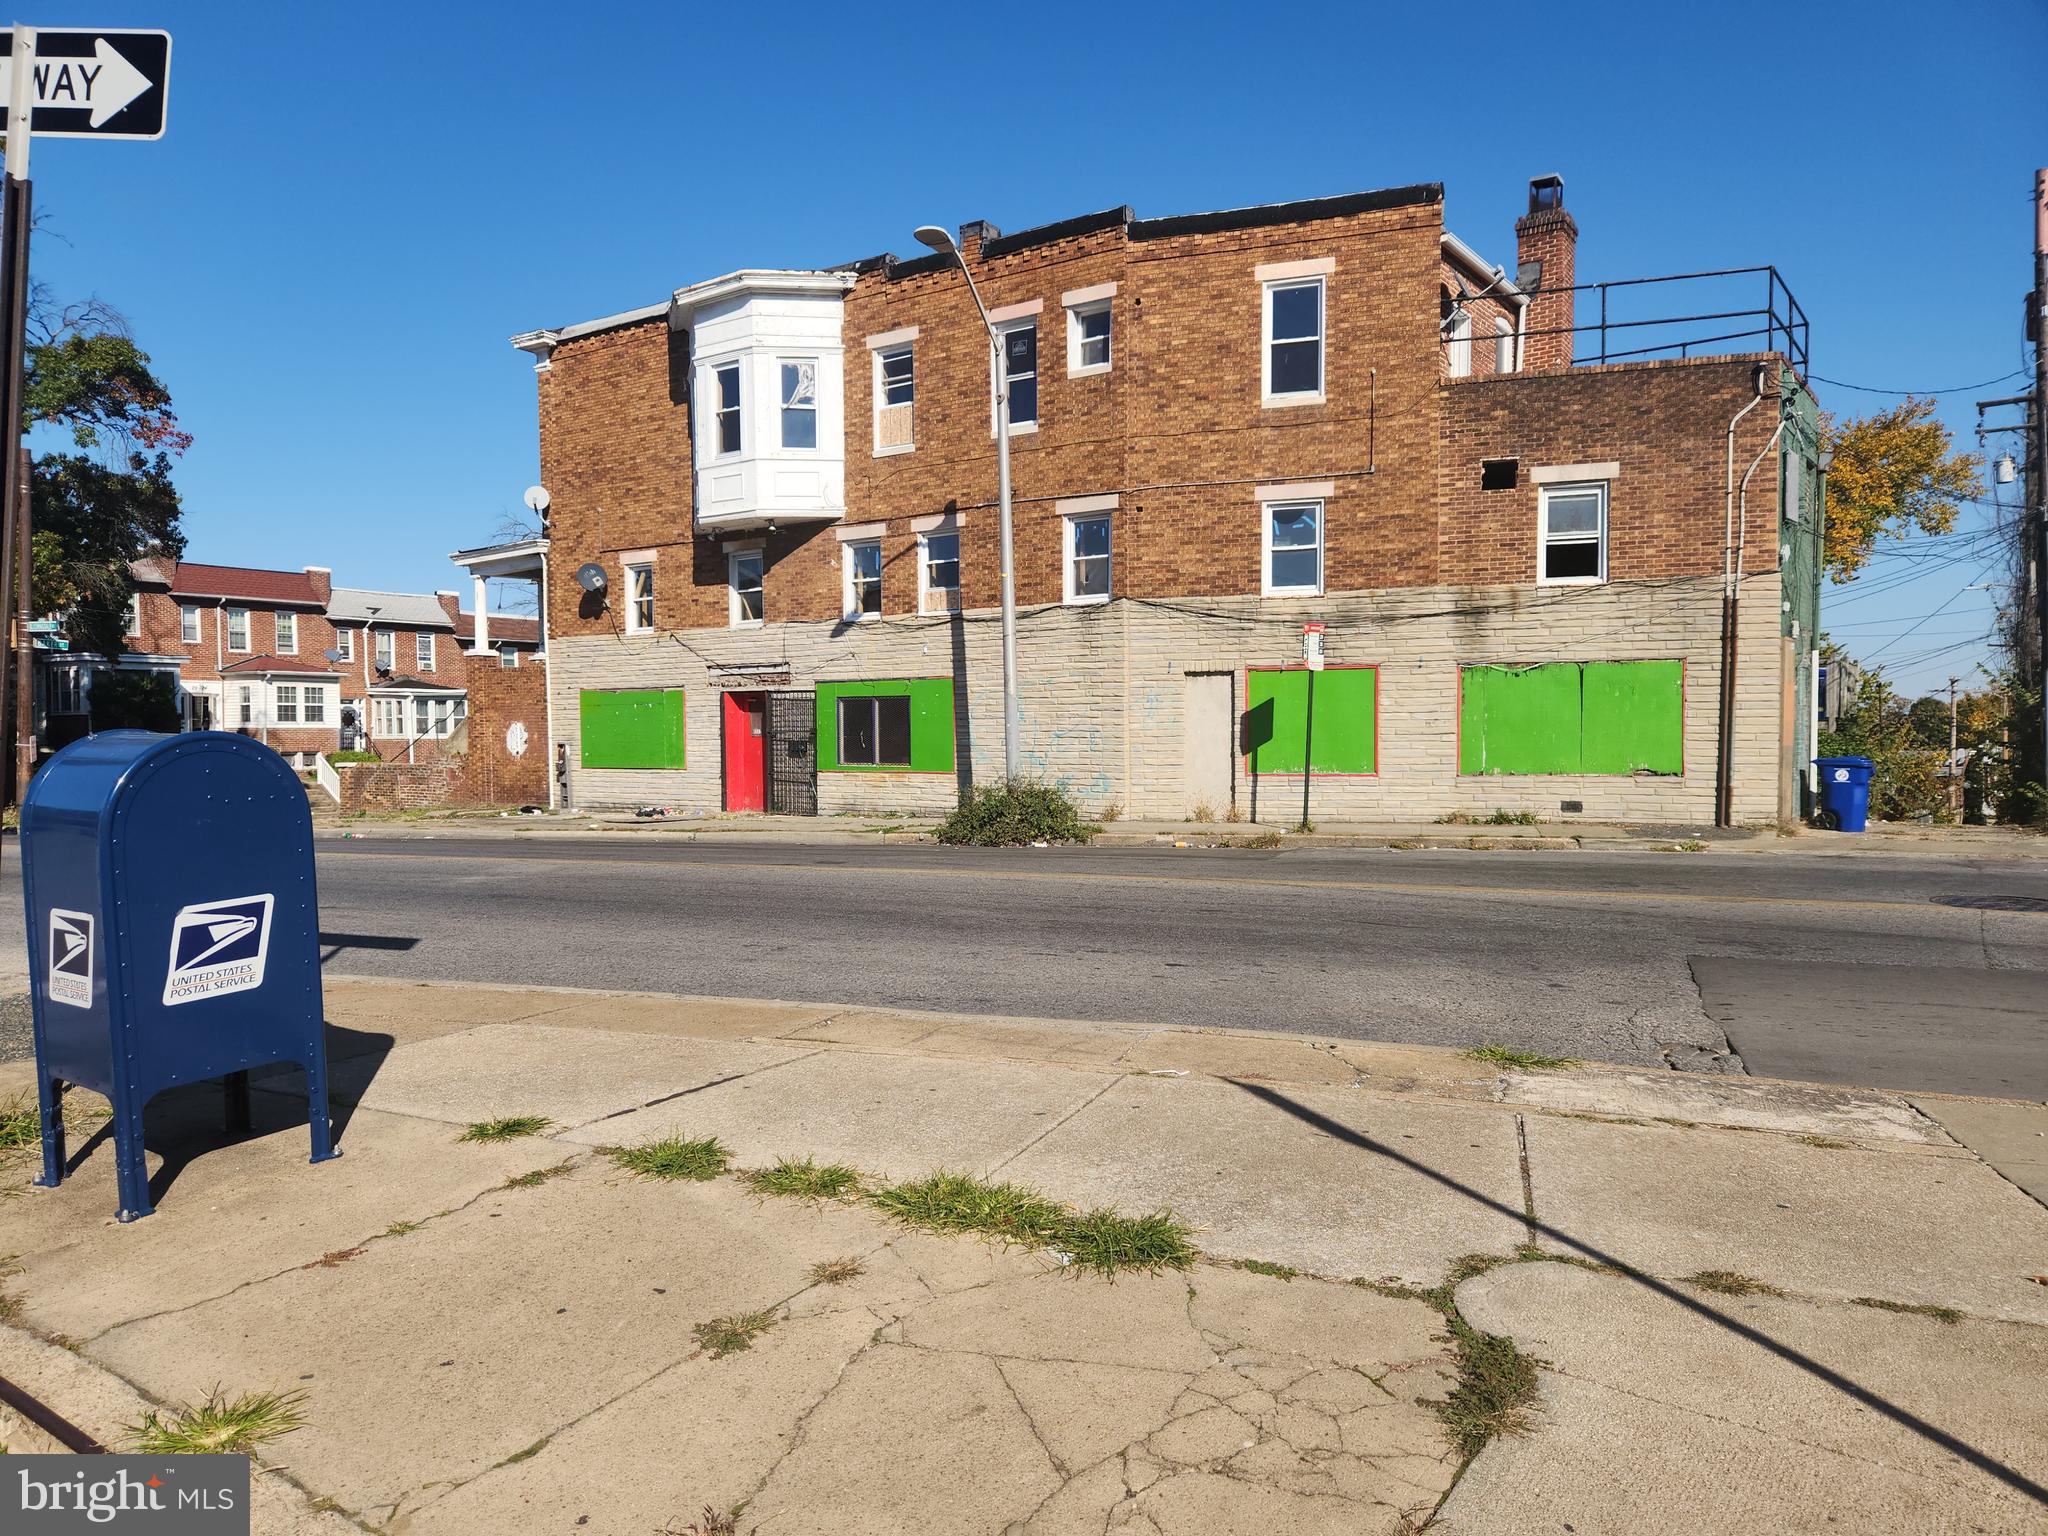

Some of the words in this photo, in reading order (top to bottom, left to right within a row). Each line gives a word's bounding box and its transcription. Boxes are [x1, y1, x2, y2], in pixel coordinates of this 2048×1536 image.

[33, 64, 103, 101] WAY
[52, 976, 70, 987] UNITED
[70, 980, 87, 990] STATES
[170, 984, 212, 998] POSTAL
[214, 974, 256, 990] SERVICE
[172, 971, 214, 987] UNITED
[216, 964, 252, 978] STATES
[52, 986, 69, 998] POSTAL
[70, 991, 89, 1002] SERVICE
